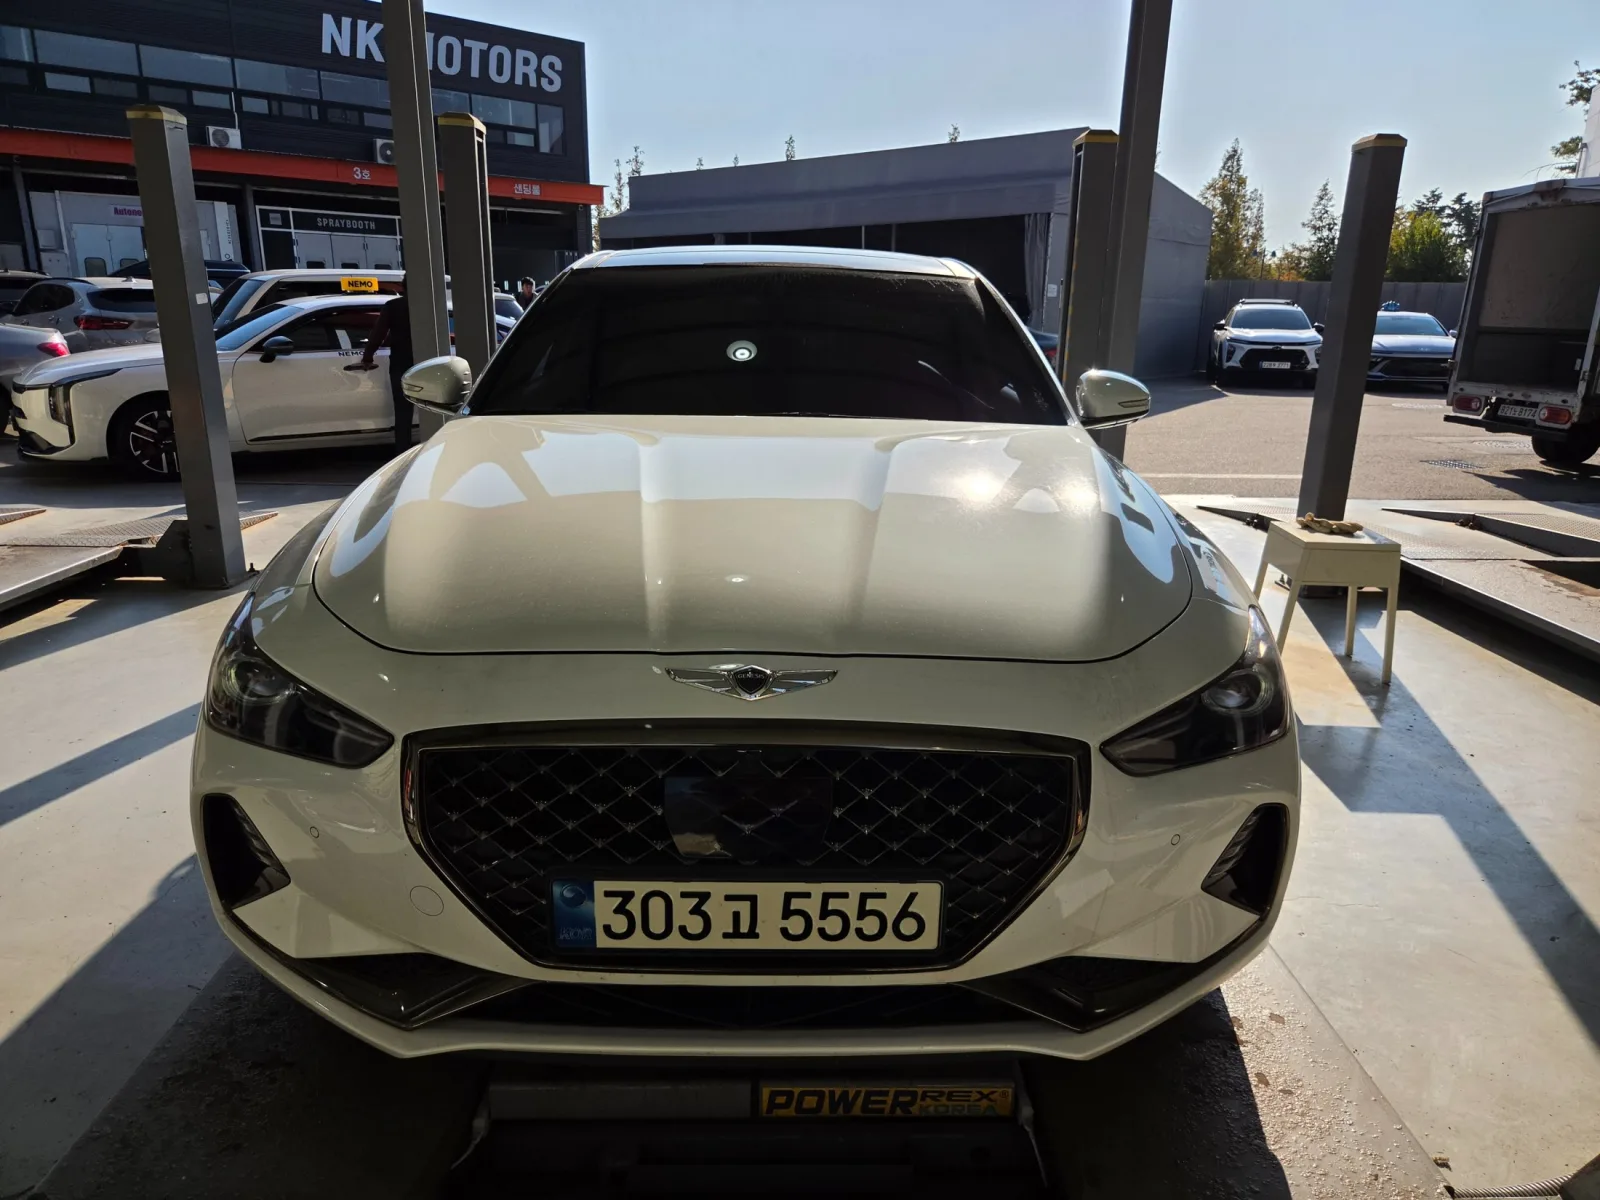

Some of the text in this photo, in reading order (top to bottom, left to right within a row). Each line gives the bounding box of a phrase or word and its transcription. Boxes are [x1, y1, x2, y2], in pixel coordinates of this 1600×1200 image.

[321, 13, 385, 63] NK
[353, 166, 371, 180] 3호
[113, 206, 142, 216] Autone
[316, 217, 376, 230] SPRAYBOOTH
[347, 280, 373, 288] NEMO
[602, 889, 926, 942] 303고 5556
[765, 1089, 917, 1115] POWER
[919, 1104, 998, 1116] KOREA
